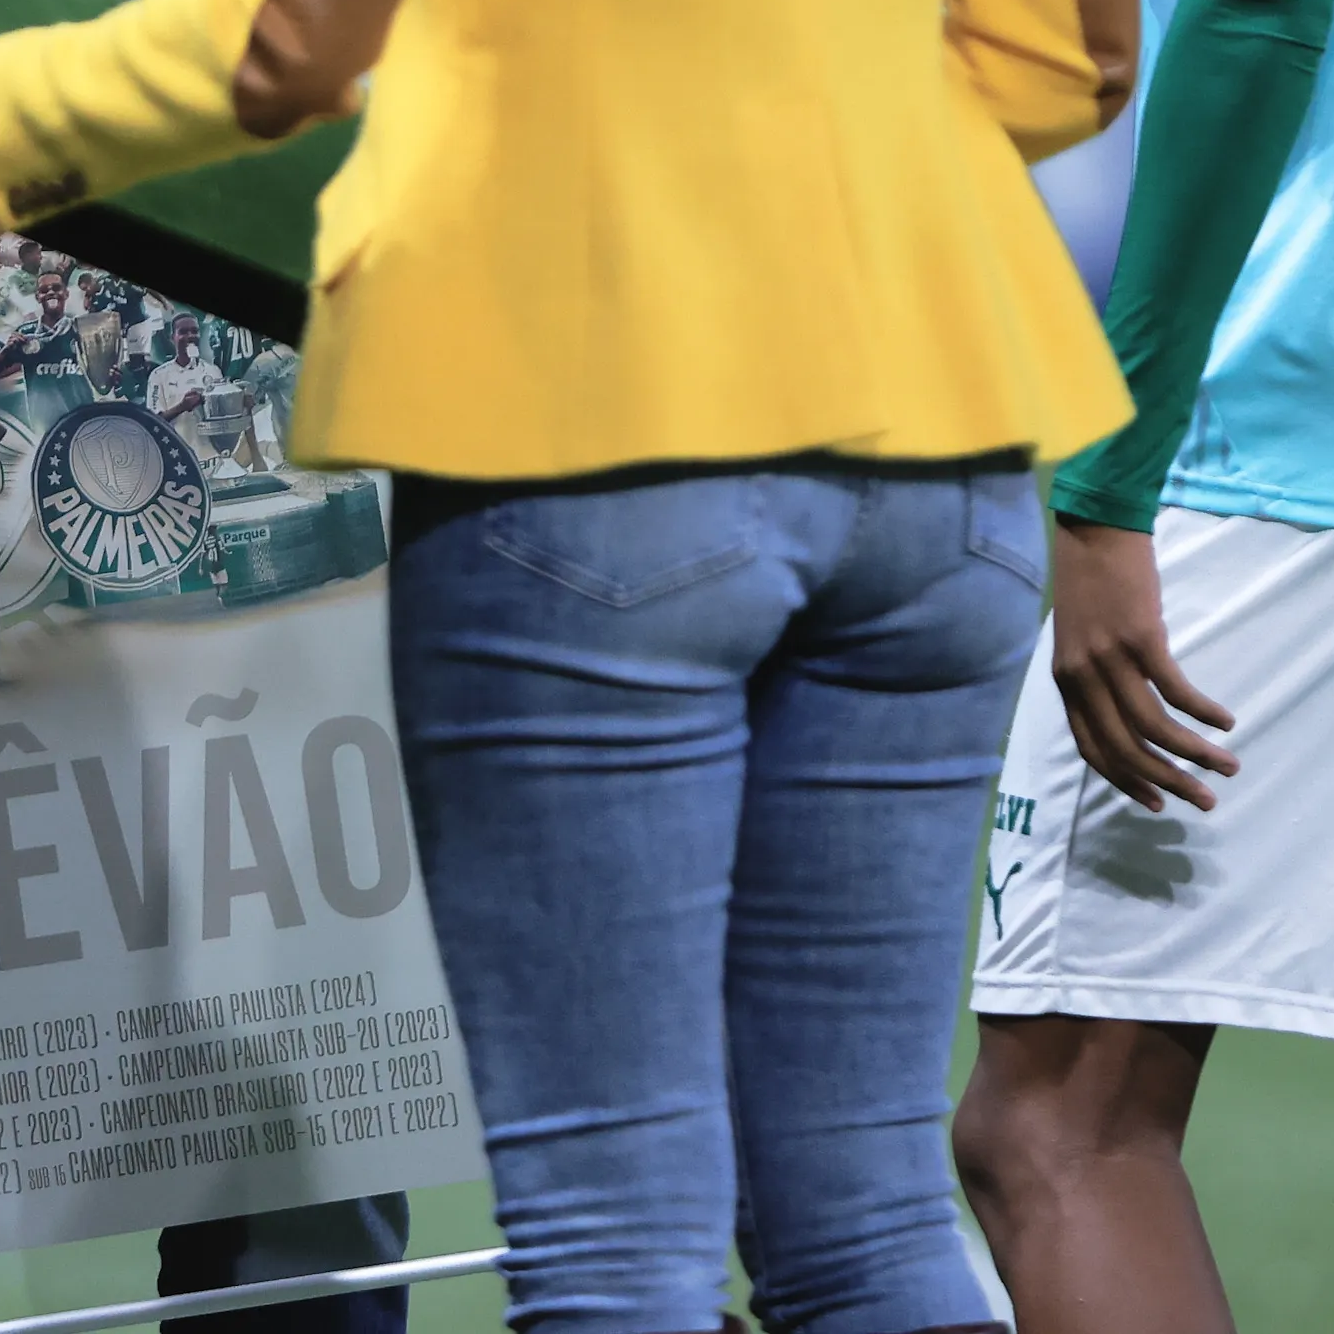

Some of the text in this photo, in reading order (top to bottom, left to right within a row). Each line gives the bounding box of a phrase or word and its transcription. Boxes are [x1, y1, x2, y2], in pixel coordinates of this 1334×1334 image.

[227, 326, 254, 359] 20
[43, 480, 204, 580] PALMEIRAS
[223, 527, 268, 544] Parque
[116, 995, 225, 1044] CAMPEONATO
[228, 983, 307, 1026] PAULISTA
[117, 1039, 228, 1087] CAMPEONATO
[231, 1027, 310, 1070] PAULISTA
[312, 1016, 380, 1058] SUB-20
[10, 1115, 24, 1149] E
[99, 1086, 209, 1134] CAMPEONATO
[213, 1071, 308, 1117] BRASILEIRO
[371, 1060, 384, 1094] E
[27, 1166, 52, 1191] SUB
[52, 1164, 67, 1187] 15
[68, 1136, 177, 1184] CAMPEONATO
[180, 1124, 259, 1167] PAULISTA
[261, 1113, 327, 1155] SUB-15
[387, 1102, 400, 1136] E
